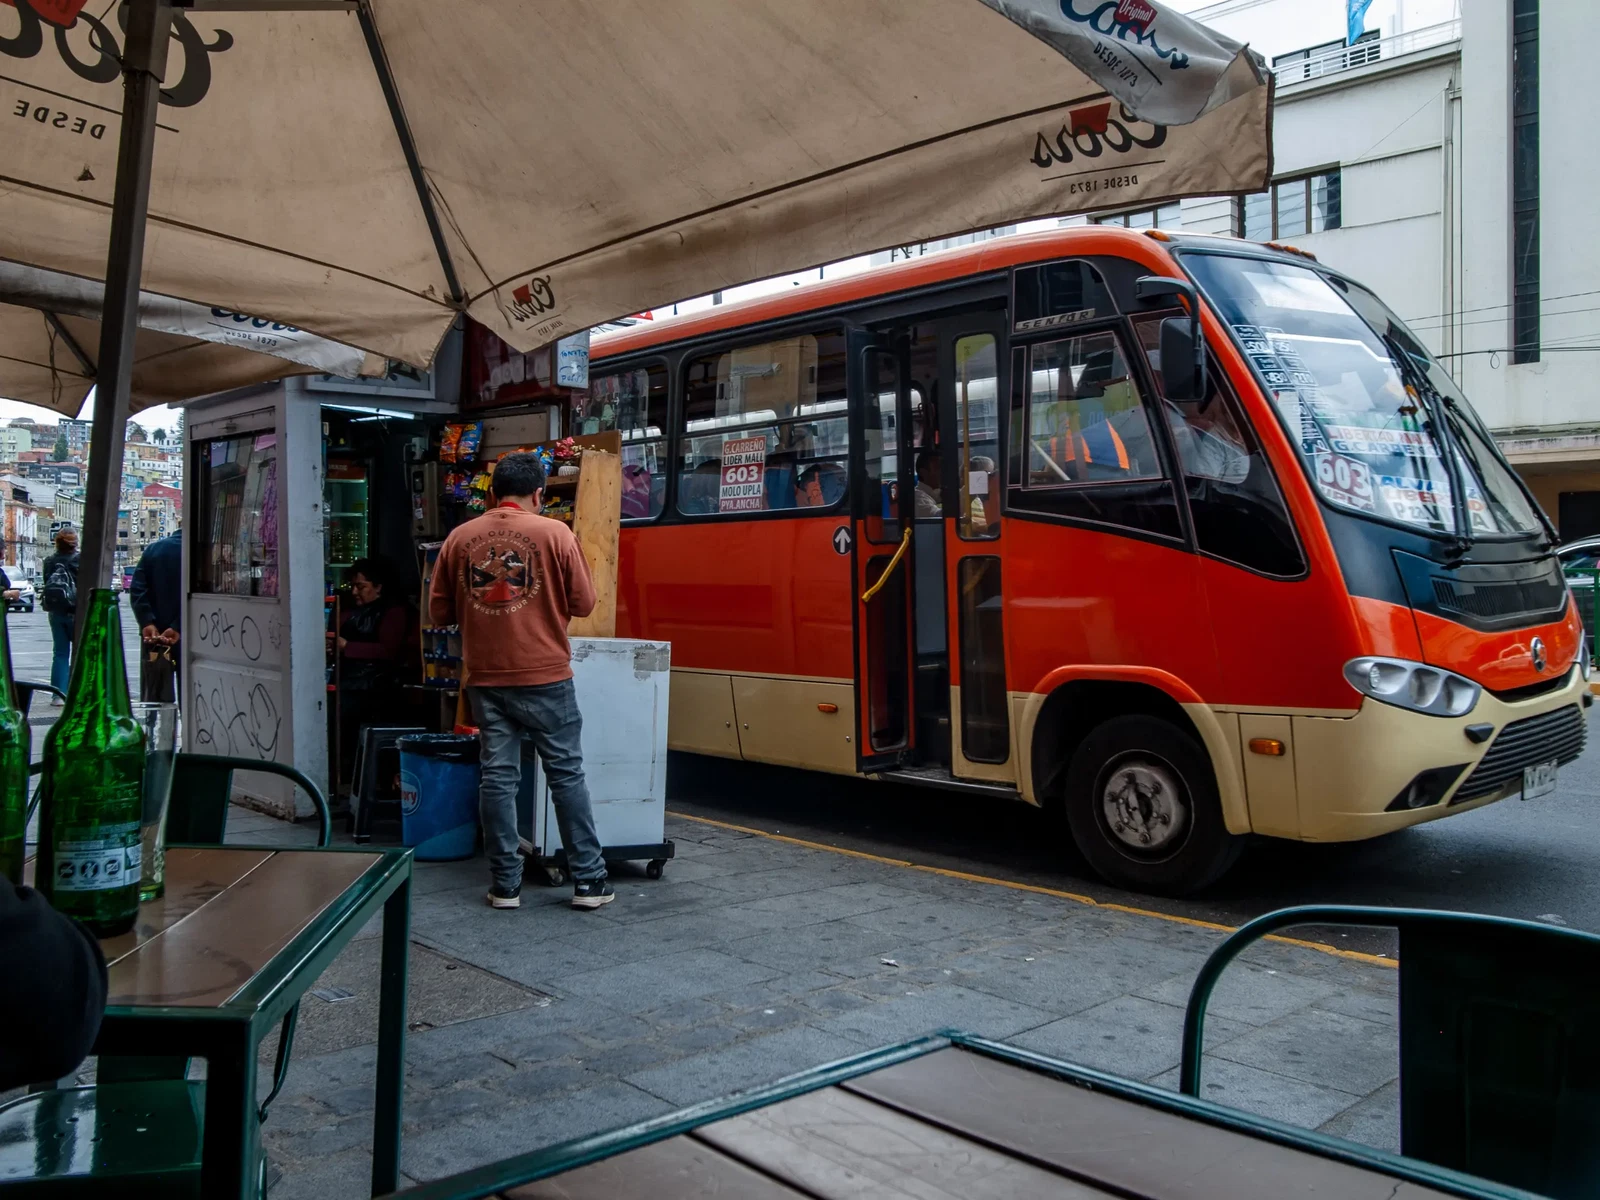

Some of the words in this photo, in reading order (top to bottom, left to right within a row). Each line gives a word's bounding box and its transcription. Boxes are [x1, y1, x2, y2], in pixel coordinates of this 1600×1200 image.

[1118, 0, 1154, 22] Original
[1093, 41, 1122, 71] DESDE
[1117, 66, 1138, 87] 1873
[256, 336, 277, 347] 1873
[723, 454, 742, 466] LIDER
[744, 452, 764, 464] MALL
[725, 465, 759, 483] 603
[1317, 453, 1371, 497] 603
[721, 485, 740, 498] MOLO
[742, 484, 761, 495] UPLA
[721, 498, 760, 510] PYA.ANCHA
[488, 530, 541, 558] OUTDOOR
[473, 602, 501, 616] WHERE
[504, 599, 528, 615] YOUR
[528, 579, 542, 599] TENT
